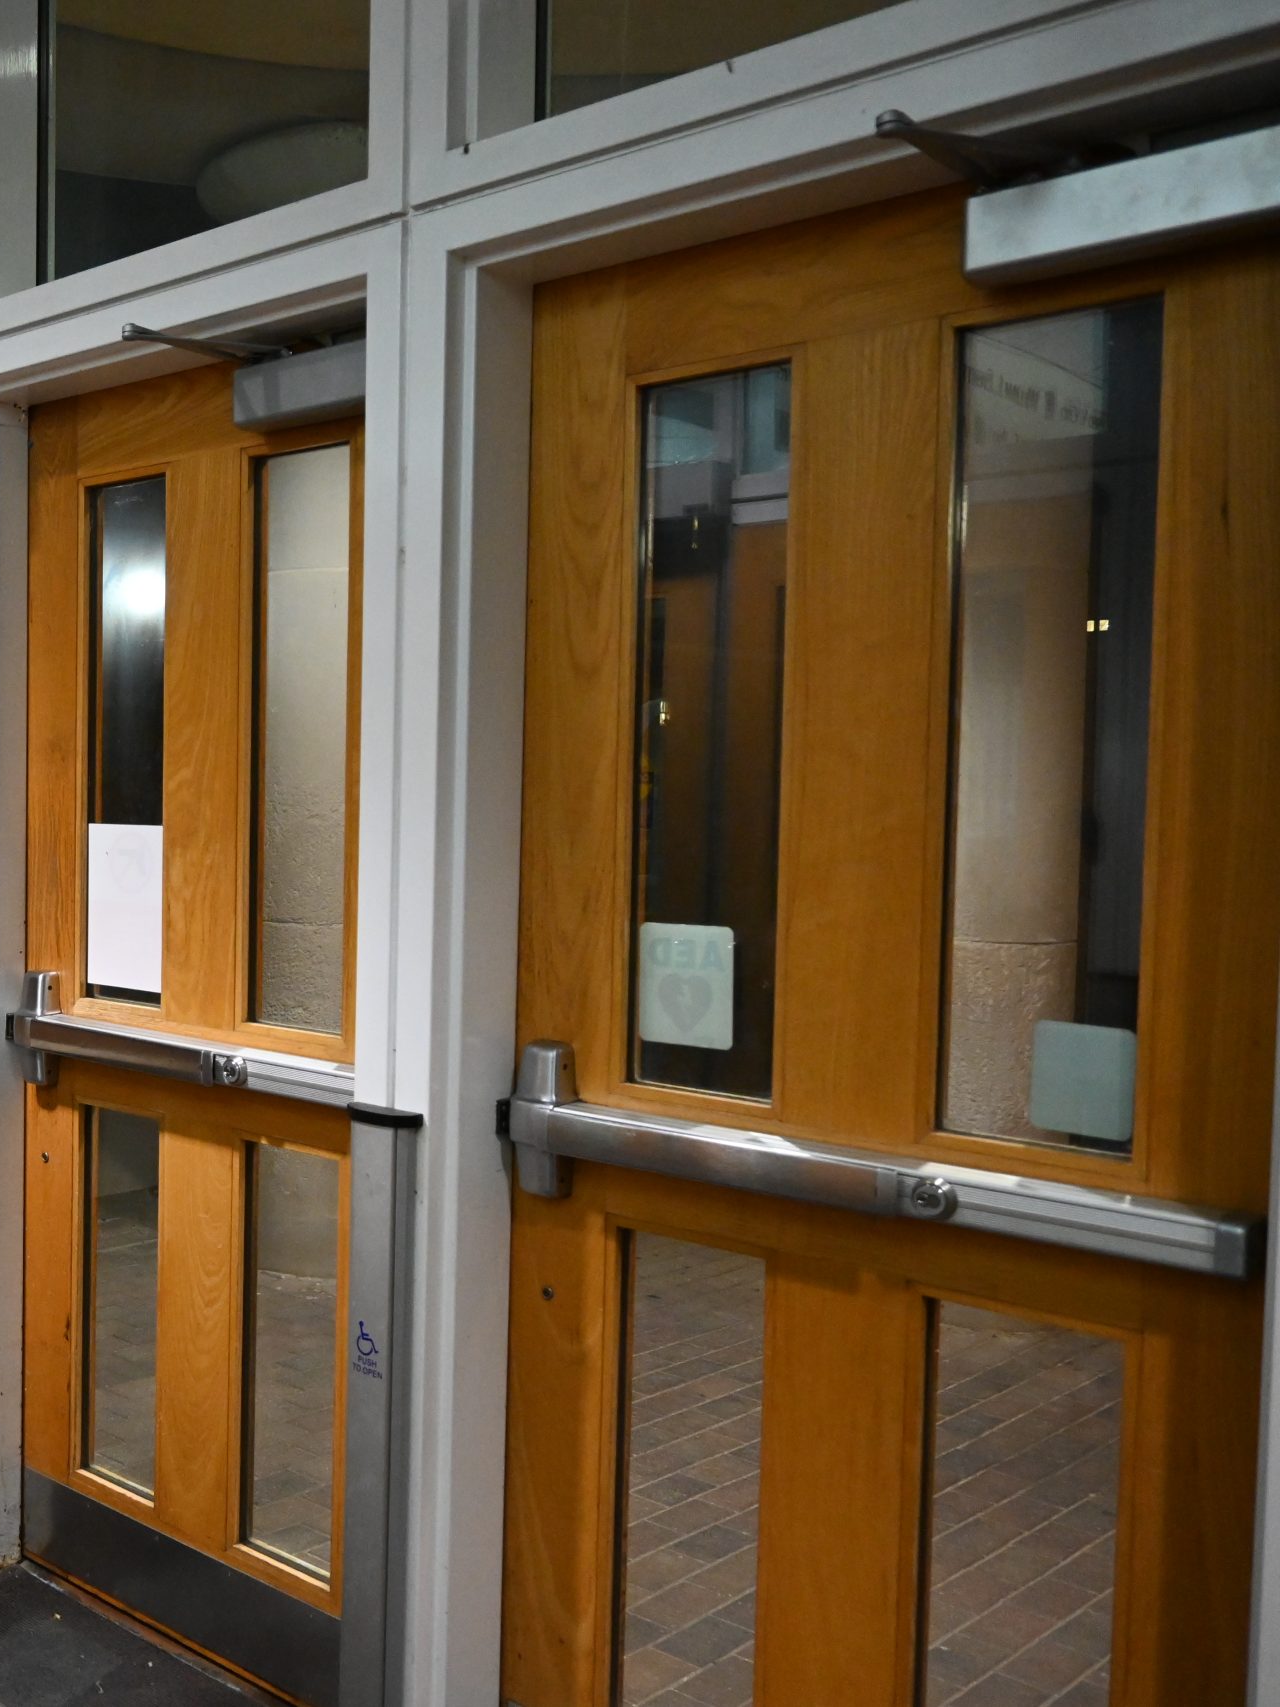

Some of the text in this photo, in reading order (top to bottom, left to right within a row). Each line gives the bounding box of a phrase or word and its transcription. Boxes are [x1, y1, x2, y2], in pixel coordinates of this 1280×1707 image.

[358, 1355, 377, 1368] PUSH
[352, 1362, 383, 1380] TO OPEN
